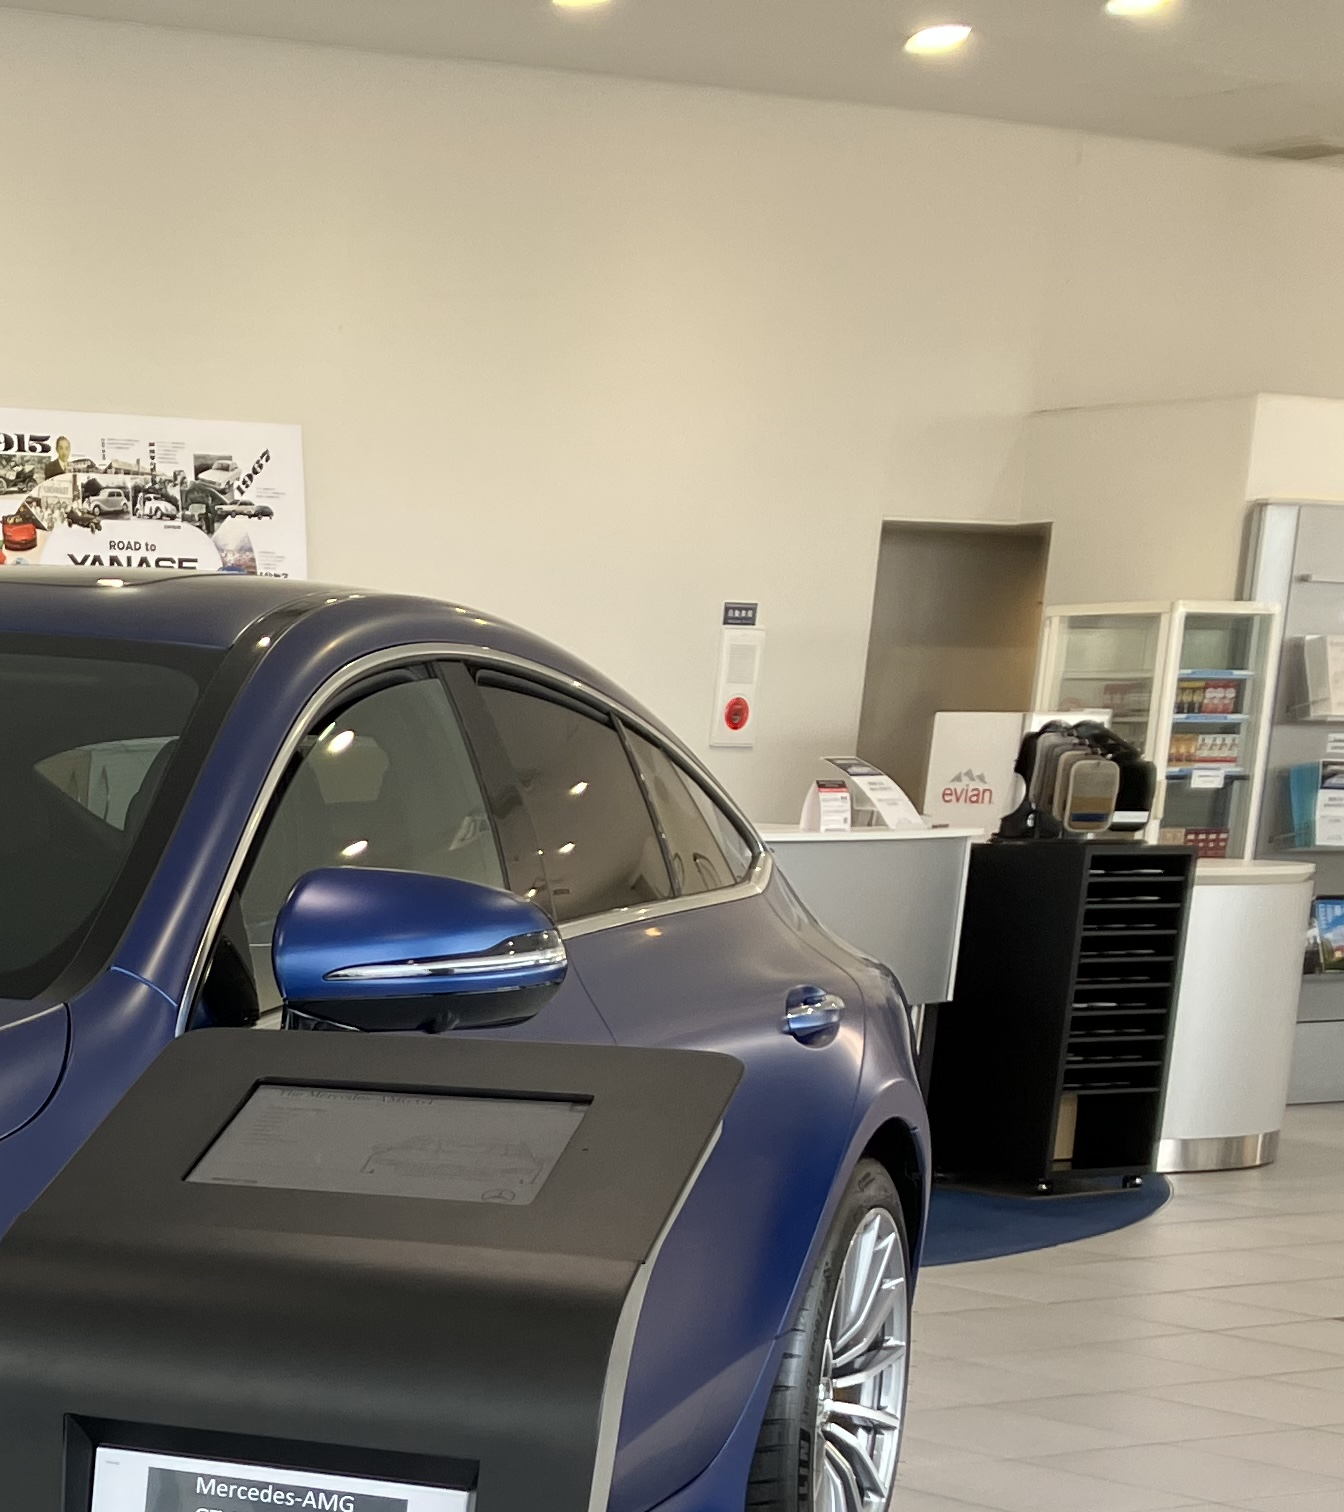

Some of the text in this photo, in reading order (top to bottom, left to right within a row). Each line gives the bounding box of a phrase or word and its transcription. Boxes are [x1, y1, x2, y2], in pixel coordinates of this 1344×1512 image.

[108, 540, 157, 552] ROAD to
[941, 784, 993, 805] evian
